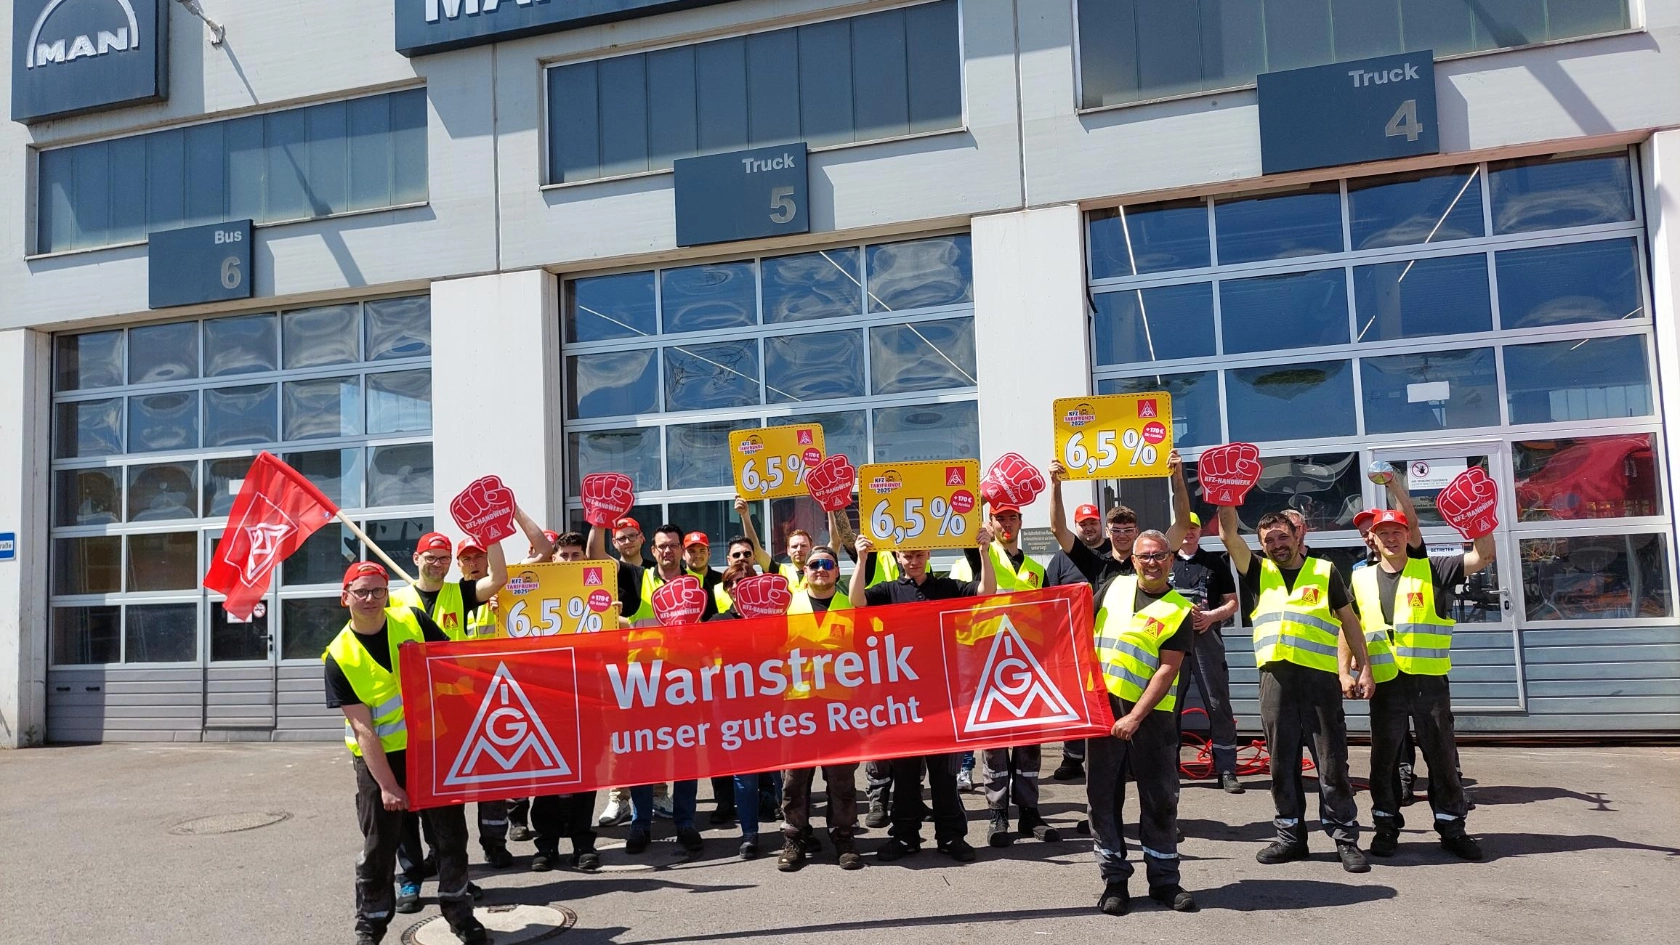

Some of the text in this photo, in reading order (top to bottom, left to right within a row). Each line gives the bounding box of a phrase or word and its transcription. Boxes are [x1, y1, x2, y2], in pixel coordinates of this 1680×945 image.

[36, 27, 127, 66] MAN
[1348, 62, 1420, 88] Truck
[1385, 99, 1424, 142] 4
[741, 152, 796, 174] Truck
[769, 185, 797, 224] 5
[214, 230, 242, 244] Bus
[220, 256, 242, 289] 6
[1065, 428, 1158, 474] 6,5 %
[742, 453, 812, 494] 6,5 %
[1204, 476, 1251, 485] KFZ-HANDWERK
[815, 481, 851, 497] KFZ-HANDWERK
[465, 506, 511, 529] KFZ-HANDWERK
[585, 497, 624, 512] KFZ-HANDWERK
[1453, 498, 1494, 522] KFZ-HANDWERK
[871, 496, 966, 545] 6,5 %
[568, 596, 603, 633] %
[660, 607, 700, 619] KFZ-HANDWERK
[742, 604, 783, 614] KFZ-HANDWERK
[605, 633, 919, 710] Warnstreik
[611, 695, 923, 754] unser gutes Recht
